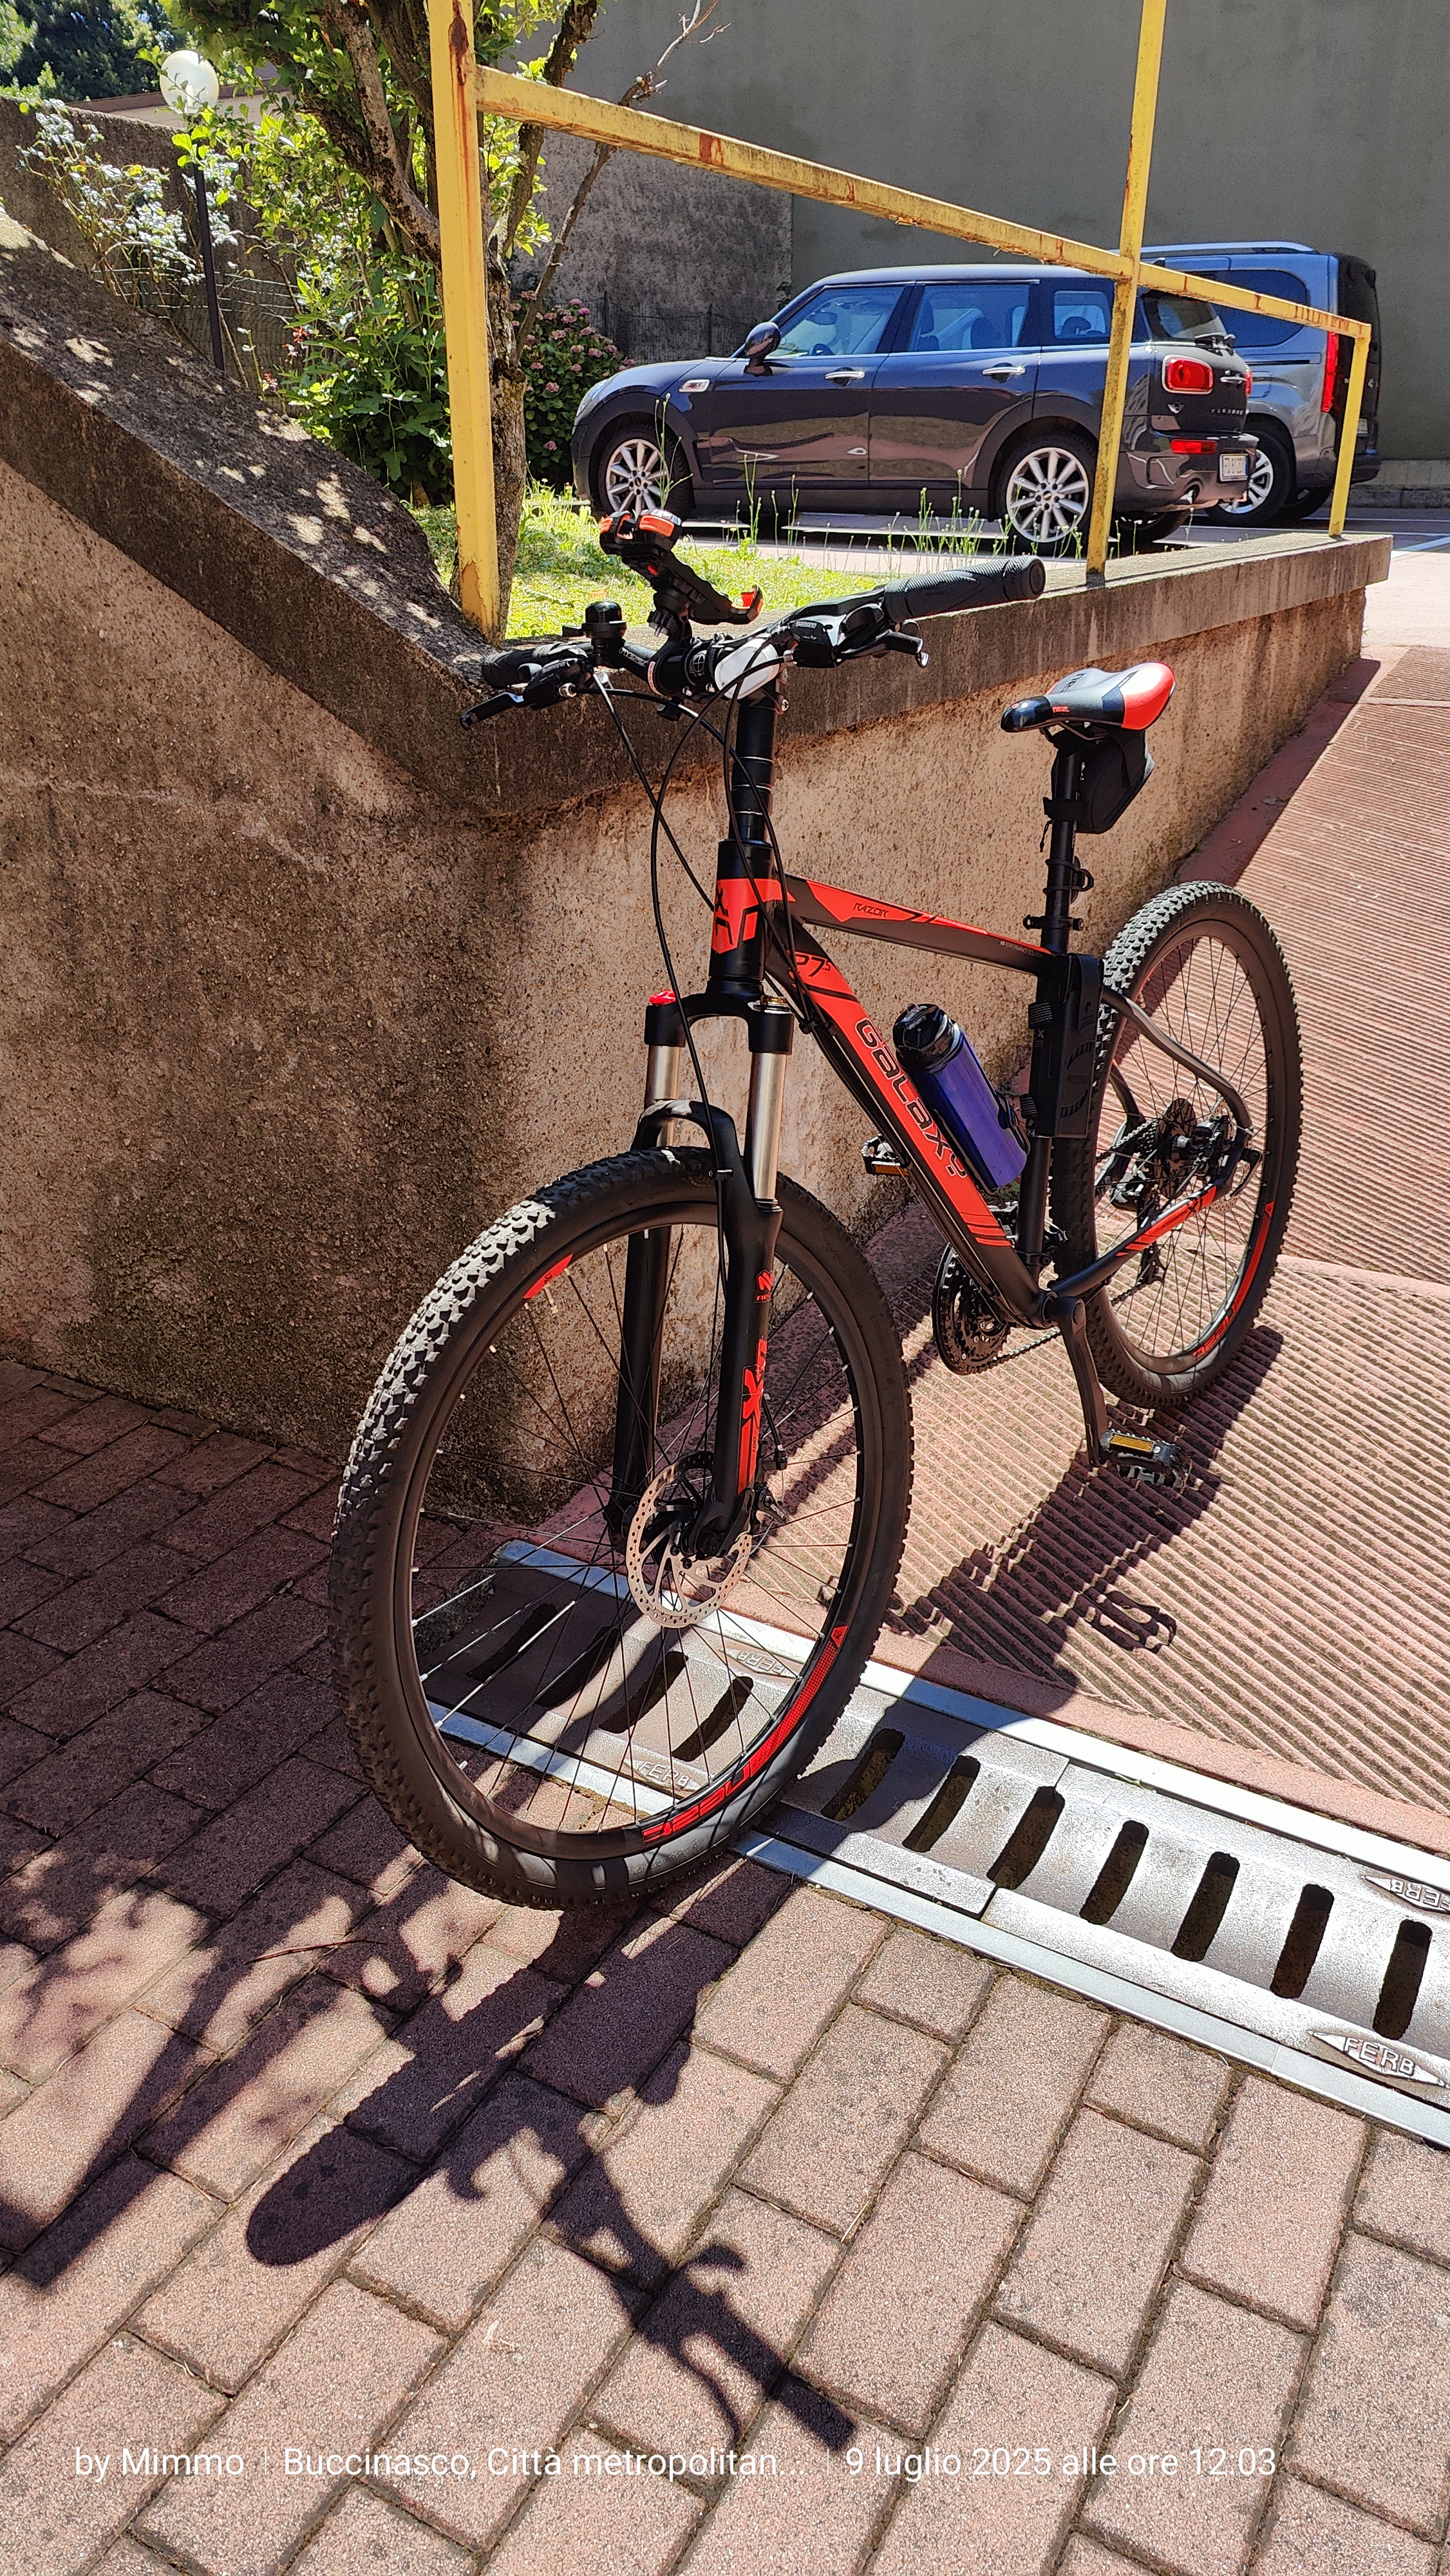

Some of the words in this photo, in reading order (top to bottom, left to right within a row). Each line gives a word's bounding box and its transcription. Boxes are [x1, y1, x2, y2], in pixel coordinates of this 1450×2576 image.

[853, 902, 889, 918] RAZOR
[737, 1651, 786, 1674] FERB
[639, 1761, 690, 1788] FERB
[1344, 2037, 1414, 2076] FERB
